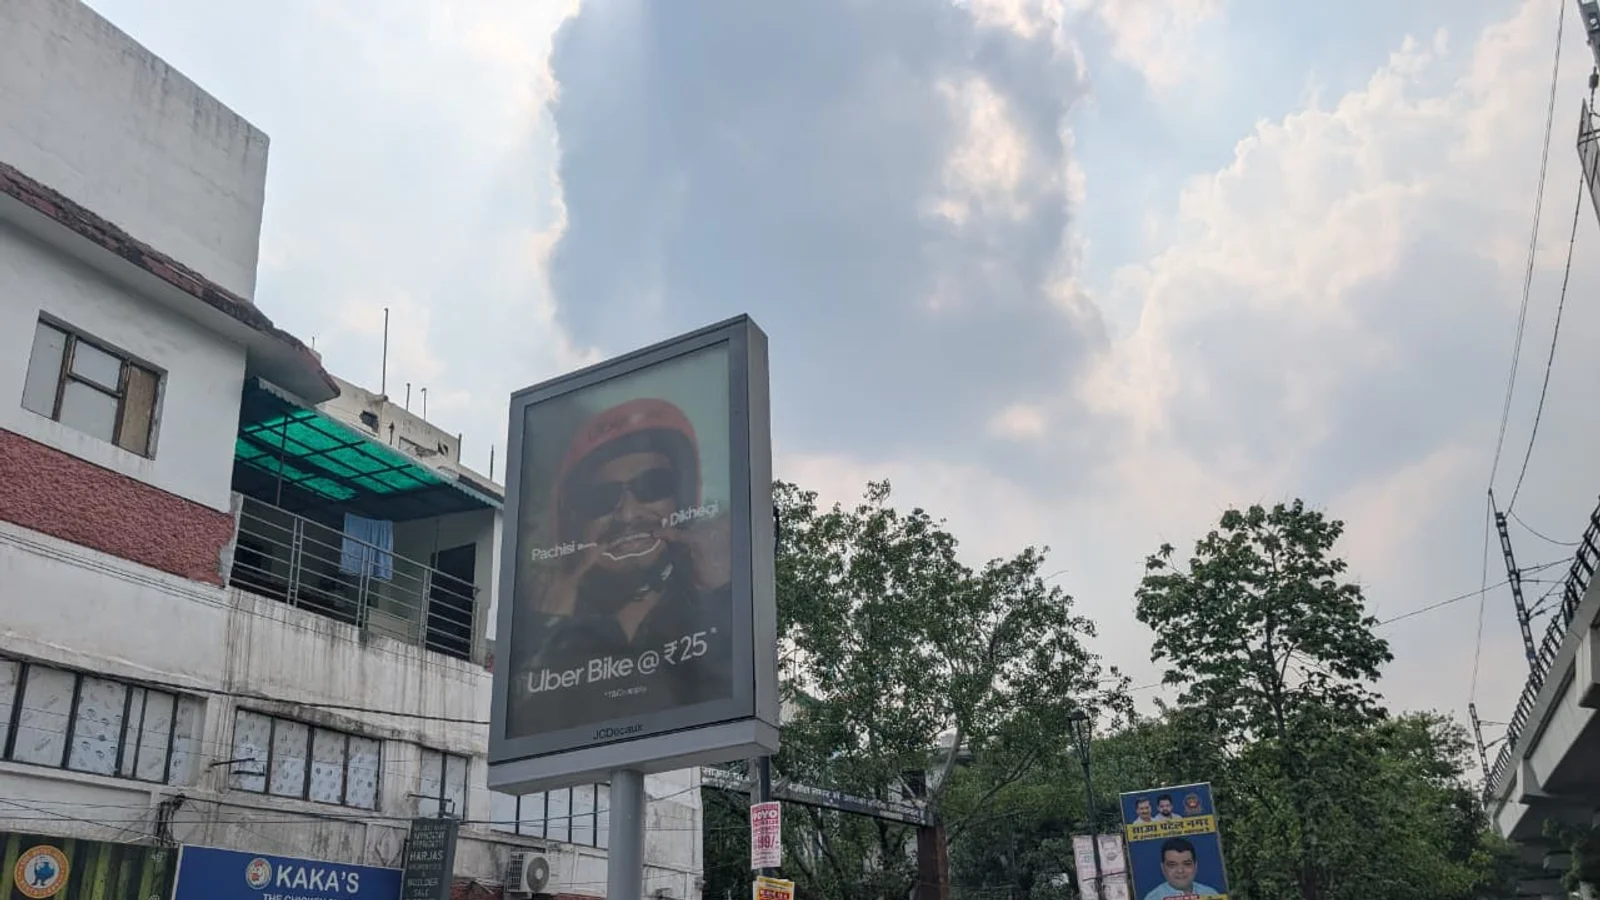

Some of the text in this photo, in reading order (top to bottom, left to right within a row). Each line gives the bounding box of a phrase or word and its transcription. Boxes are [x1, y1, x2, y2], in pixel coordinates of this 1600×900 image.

[669, 500, 719, 527] Dikhegi
[531, 540, 576, 561] Pachisi
[527, 668, 584, 693] Uber
[587, 656, 634, 683] Bike
[637, 650, 659, 675] @
[275, 864, 360, 894] KAKA'S
